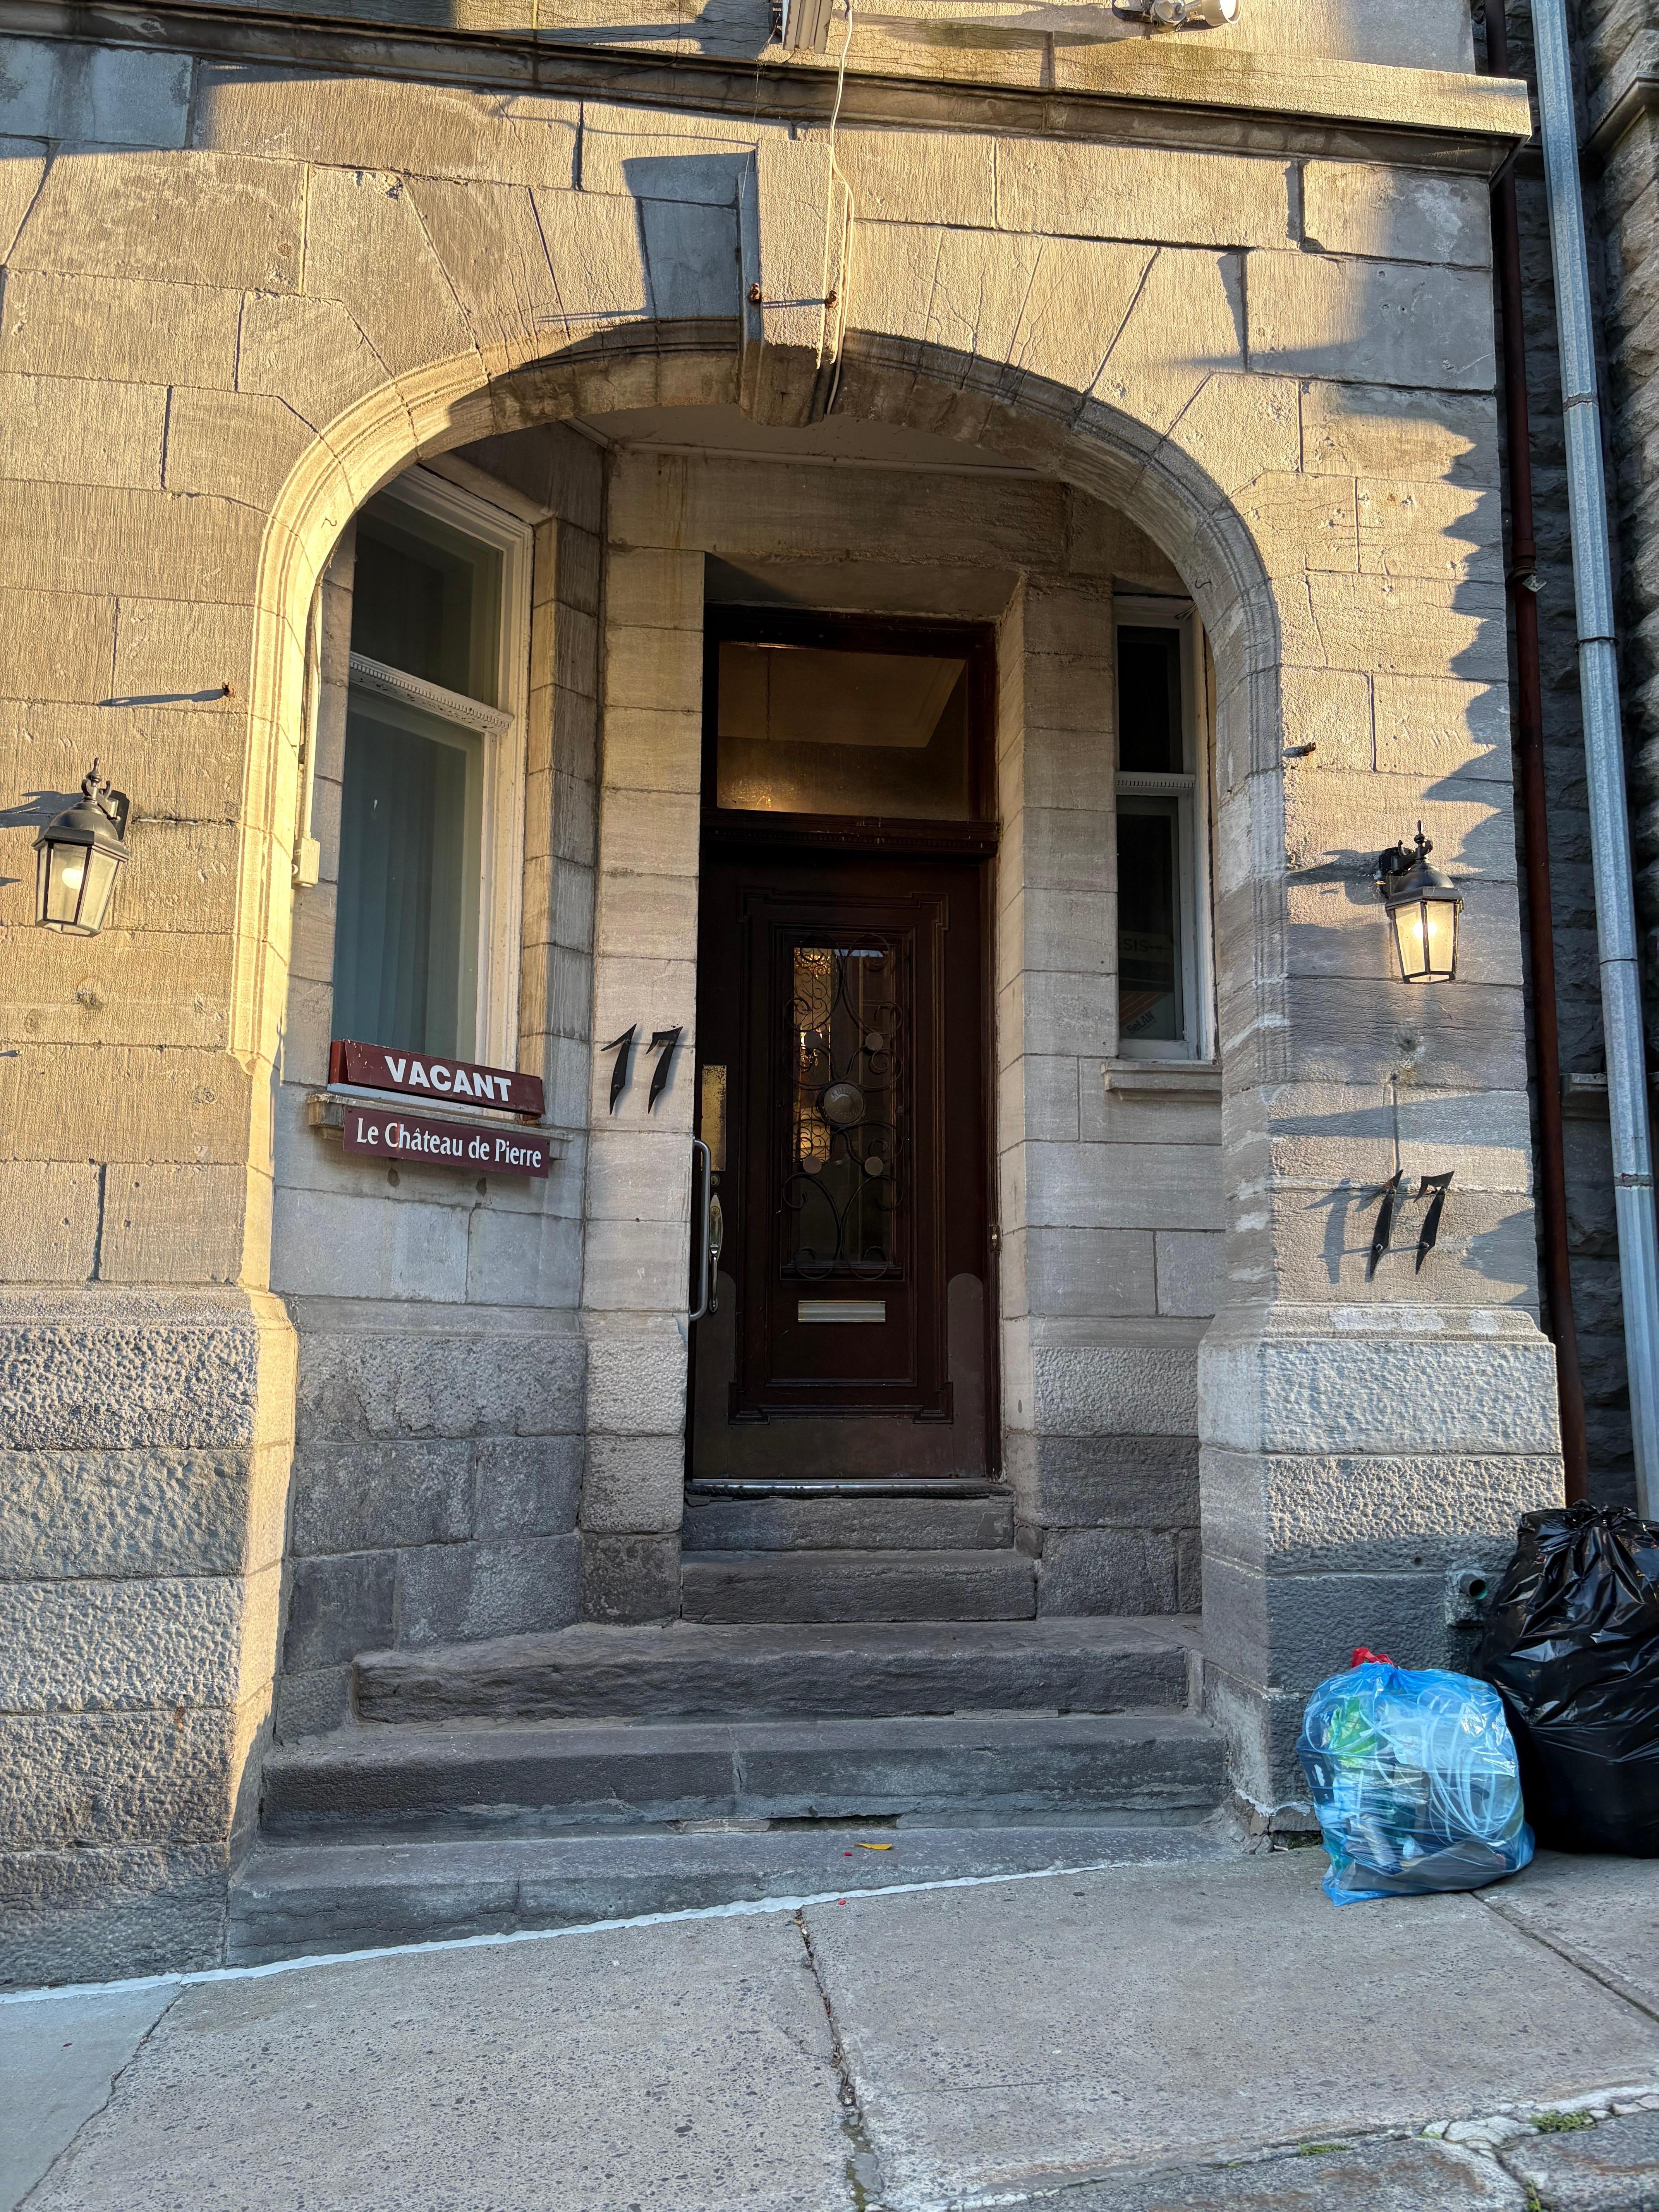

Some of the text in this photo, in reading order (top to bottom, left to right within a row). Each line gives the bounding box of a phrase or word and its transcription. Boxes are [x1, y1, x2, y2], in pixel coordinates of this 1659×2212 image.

[384, 1056, 511, 1101] VACANT
[601, 1024, 683, 1115] 17
[356, 1118, 542, 1168] Le Château de Pierre
[1364, 1169, 1455, 1278] 17
